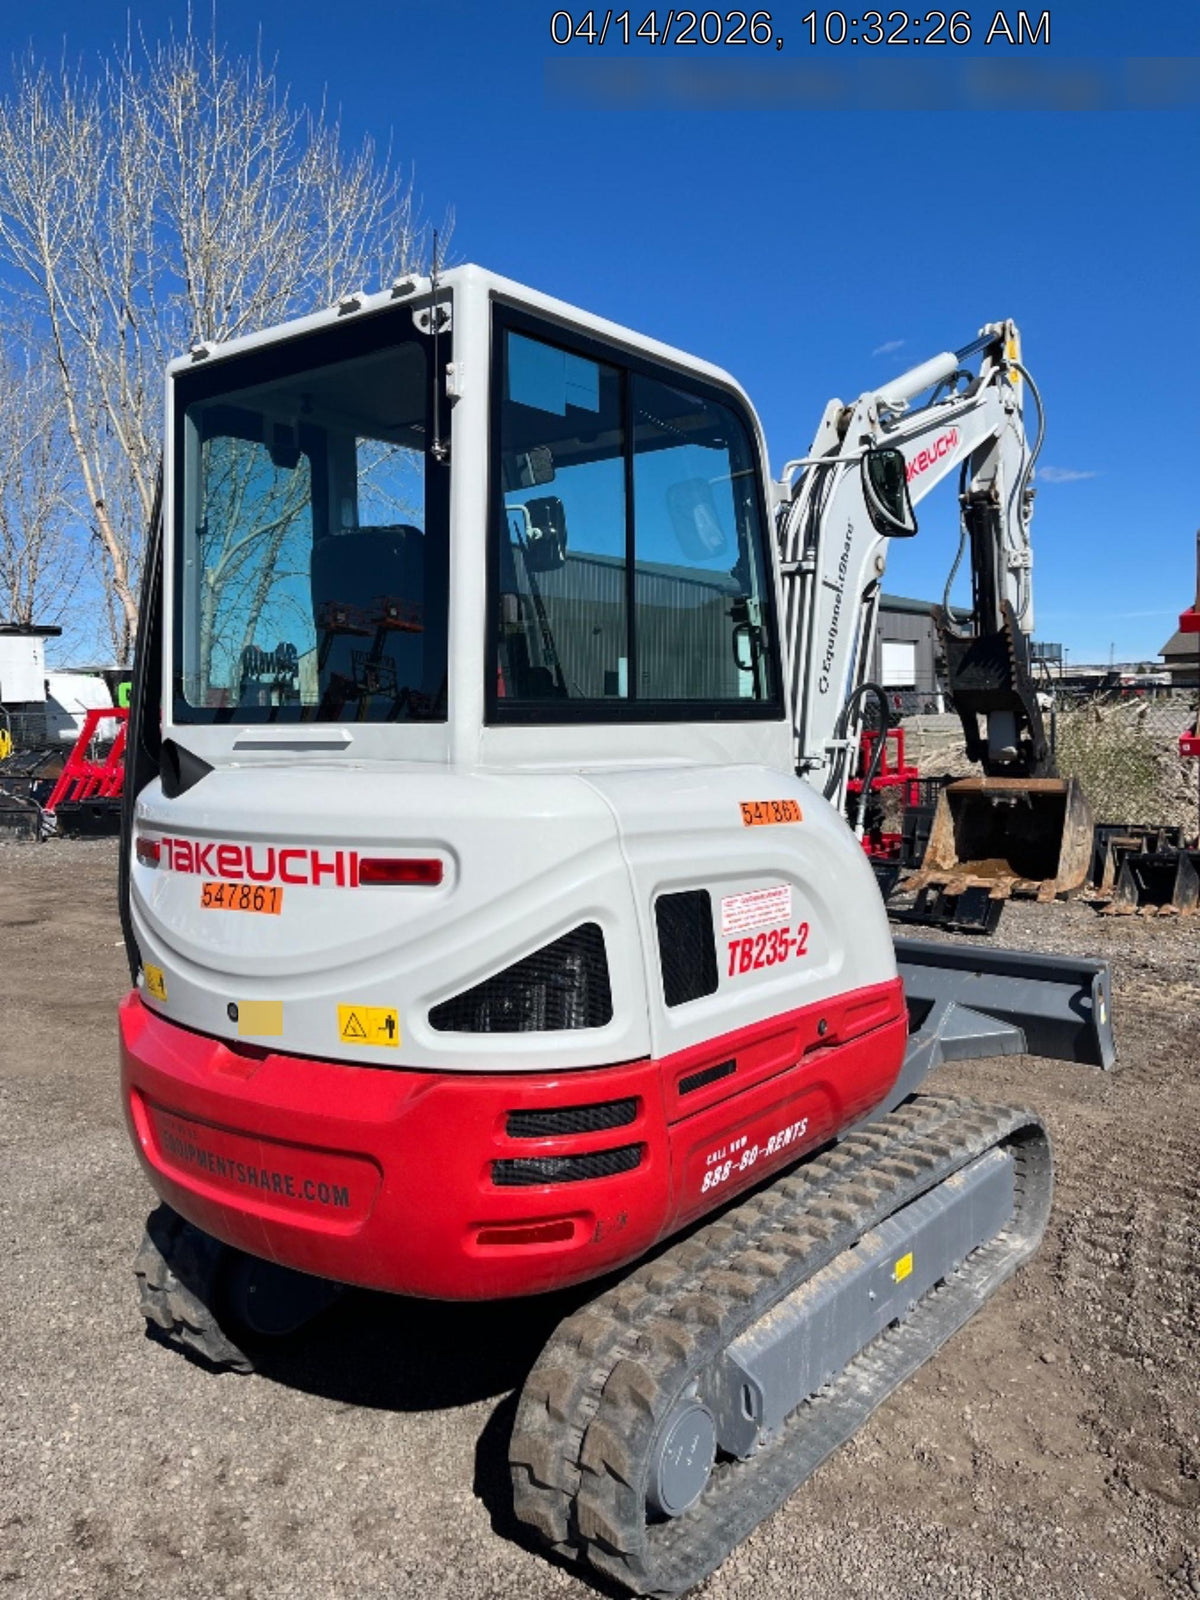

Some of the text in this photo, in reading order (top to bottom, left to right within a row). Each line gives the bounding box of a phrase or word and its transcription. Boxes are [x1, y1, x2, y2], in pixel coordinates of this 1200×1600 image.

[741, 800, 801, 826] 547861
[202, 883, 278, 912] 547861
[728, 921, 809, 976] TB235-2
[701, 1118, 808, 1193] 888-80-RENTS
